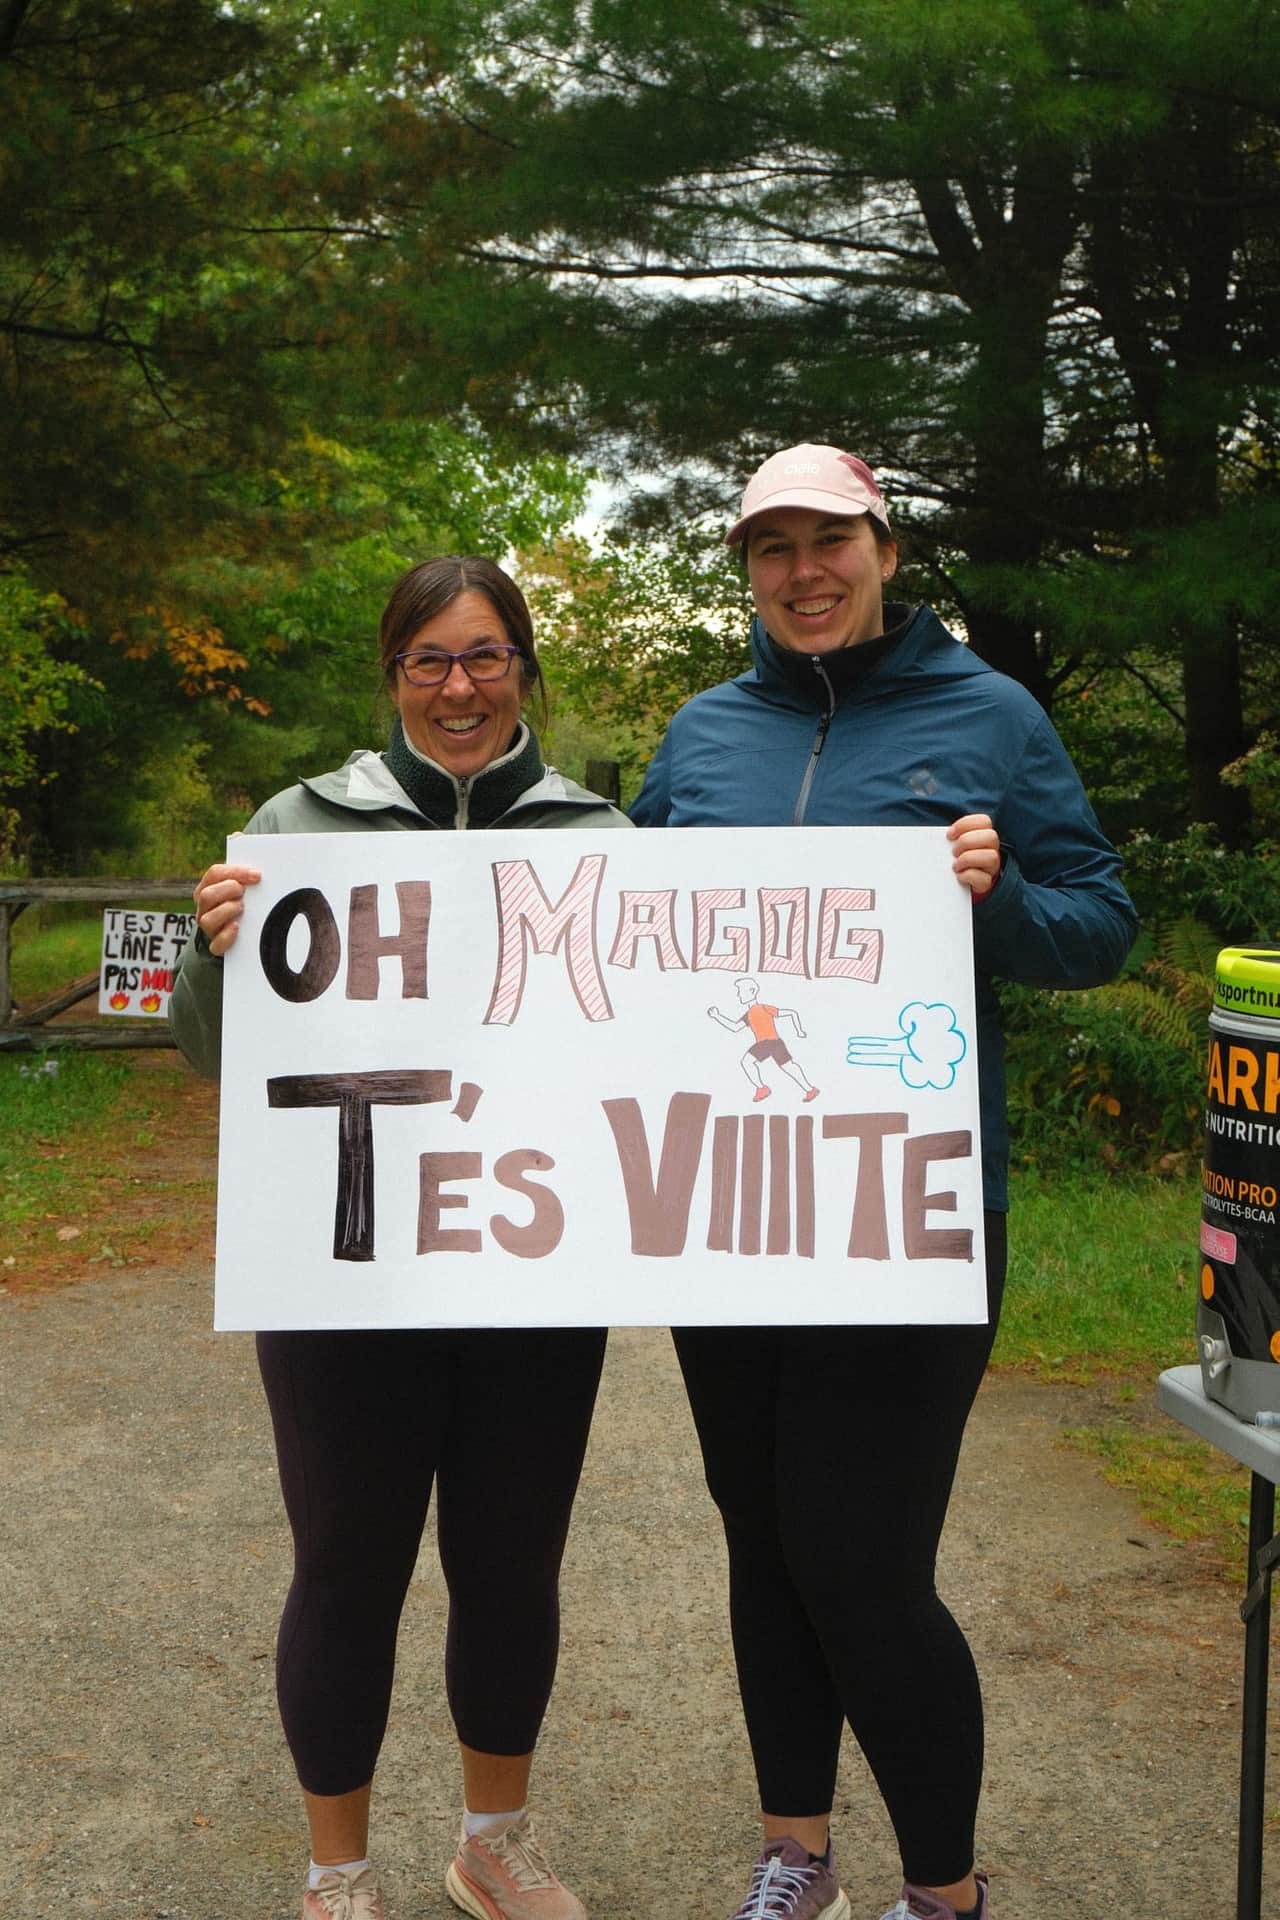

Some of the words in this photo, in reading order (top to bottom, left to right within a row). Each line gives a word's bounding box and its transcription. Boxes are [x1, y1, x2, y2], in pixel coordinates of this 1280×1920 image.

[163, 914, 196, 936] PAS
[260, 880, 431, 1003] OH
[482, 854, 885, 1027] MAGOG
[104, 964, 141, 991] PAS
[1208, 1040, 1280, 1114] ARK
[266, 1070, 565, 1262] T'ES
[1238, 1180, 1277, 1208] PRO
